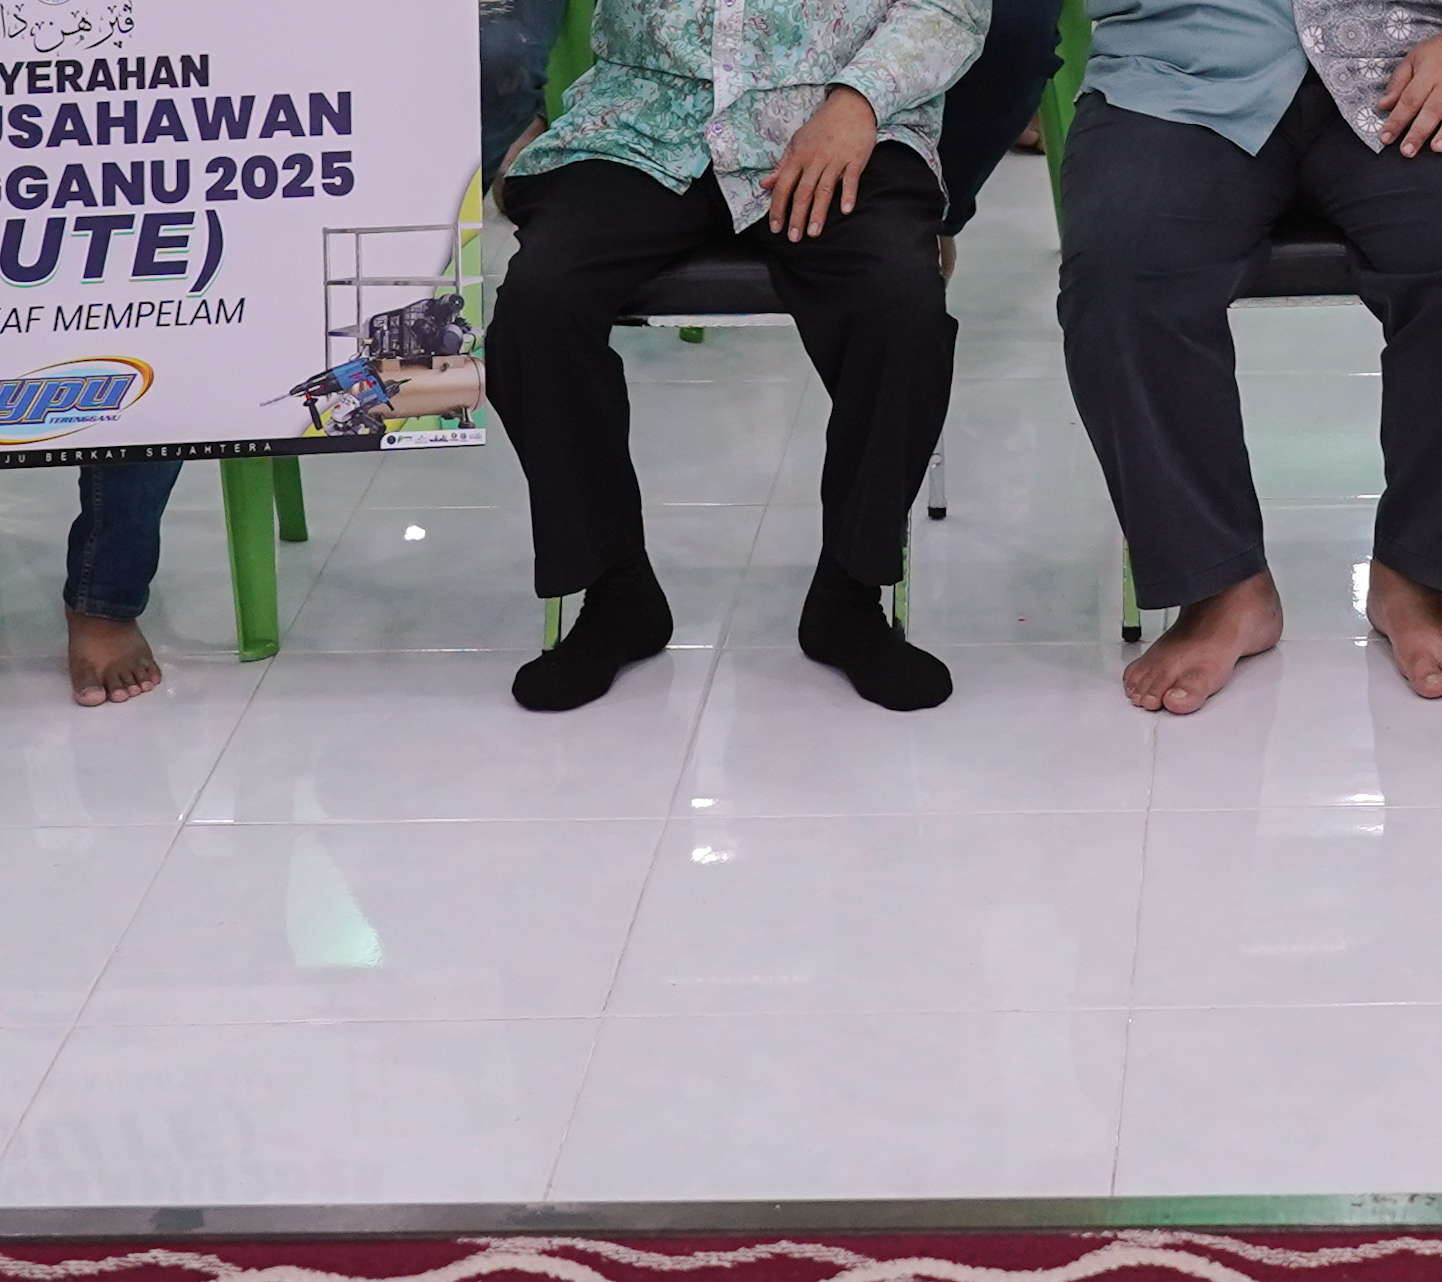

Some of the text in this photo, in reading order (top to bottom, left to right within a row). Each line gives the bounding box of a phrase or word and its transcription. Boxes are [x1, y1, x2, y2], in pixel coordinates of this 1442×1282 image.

[205, 150, 355, 201] 2025
[52, 297, 246, 333] MEMPELAM
[49, 414, 121, 425] TERENGGANU
[45, 448, 127, 462] BERKAT
[145, 442, 273, 458] SEJAHTERA
